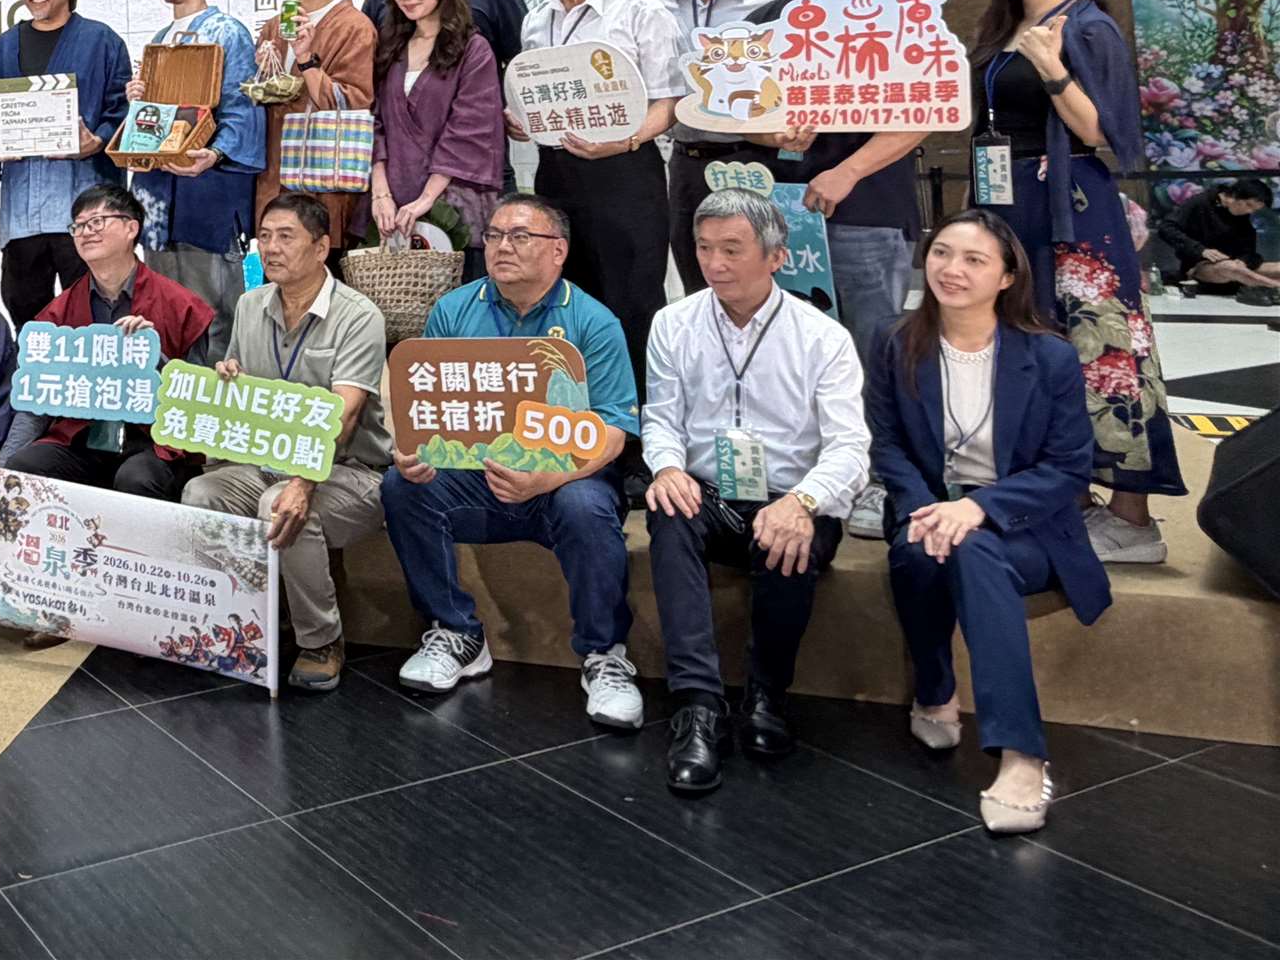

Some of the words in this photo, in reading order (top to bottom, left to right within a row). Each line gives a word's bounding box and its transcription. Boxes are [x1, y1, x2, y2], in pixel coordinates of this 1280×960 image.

[520, 80, 587, 105] 台灣好湯
[786, 80, 960, 106] 苗栗泰安溫泉季
[785, 107, 960, 126] 2026/10/17-10/18
[711, 169, 767, 190] 打卡送
[25, 331, 151, 369] 雙11限時
[17, 373, 154, 413] 1元搶泡湯
[408, 361, 538, 393] 谷關健行
[166, 368, 336, 431] 加LINE好友
[408, 400, 505, 432] 住宿折
[523, 410, 597, 450] 500
[160, 406, 325, 471] 免費送50點
[718, 439, 731, 470] PASS
[722, 473, 734, 495] VIP
[17, 533, 98, 580] 溫泉季
[103, 571, 216, 607] 台灣台北北投溫泉
